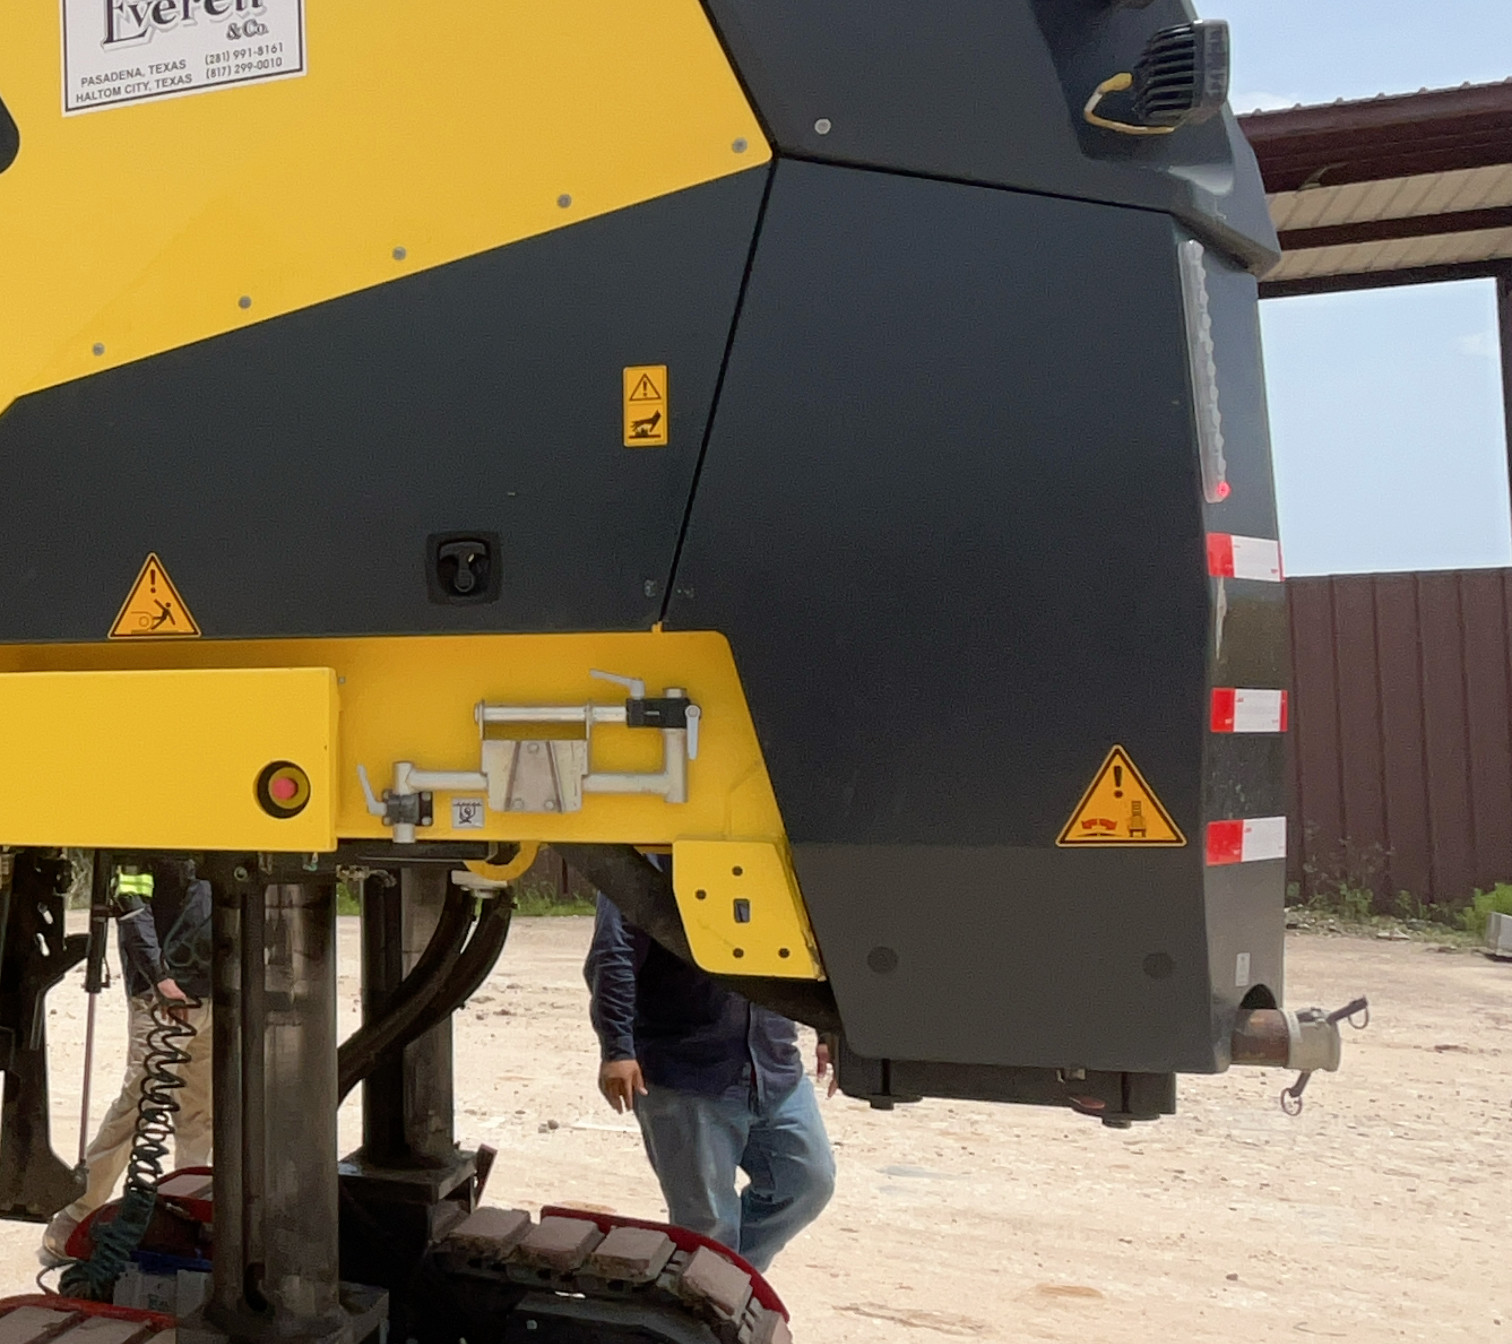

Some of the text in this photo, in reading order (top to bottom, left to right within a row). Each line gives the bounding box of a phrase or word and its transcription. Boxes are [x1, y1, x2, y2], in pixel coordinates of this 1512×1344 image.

[205, 42, 283, 66] (281) 991-8161
[81, 59, 187, 88] PASADENA, TEXAS
[206, 57, 283, 80] (817) 299-0010
[76, 74, 193, 104] HALTOM CITY, TEXAS
